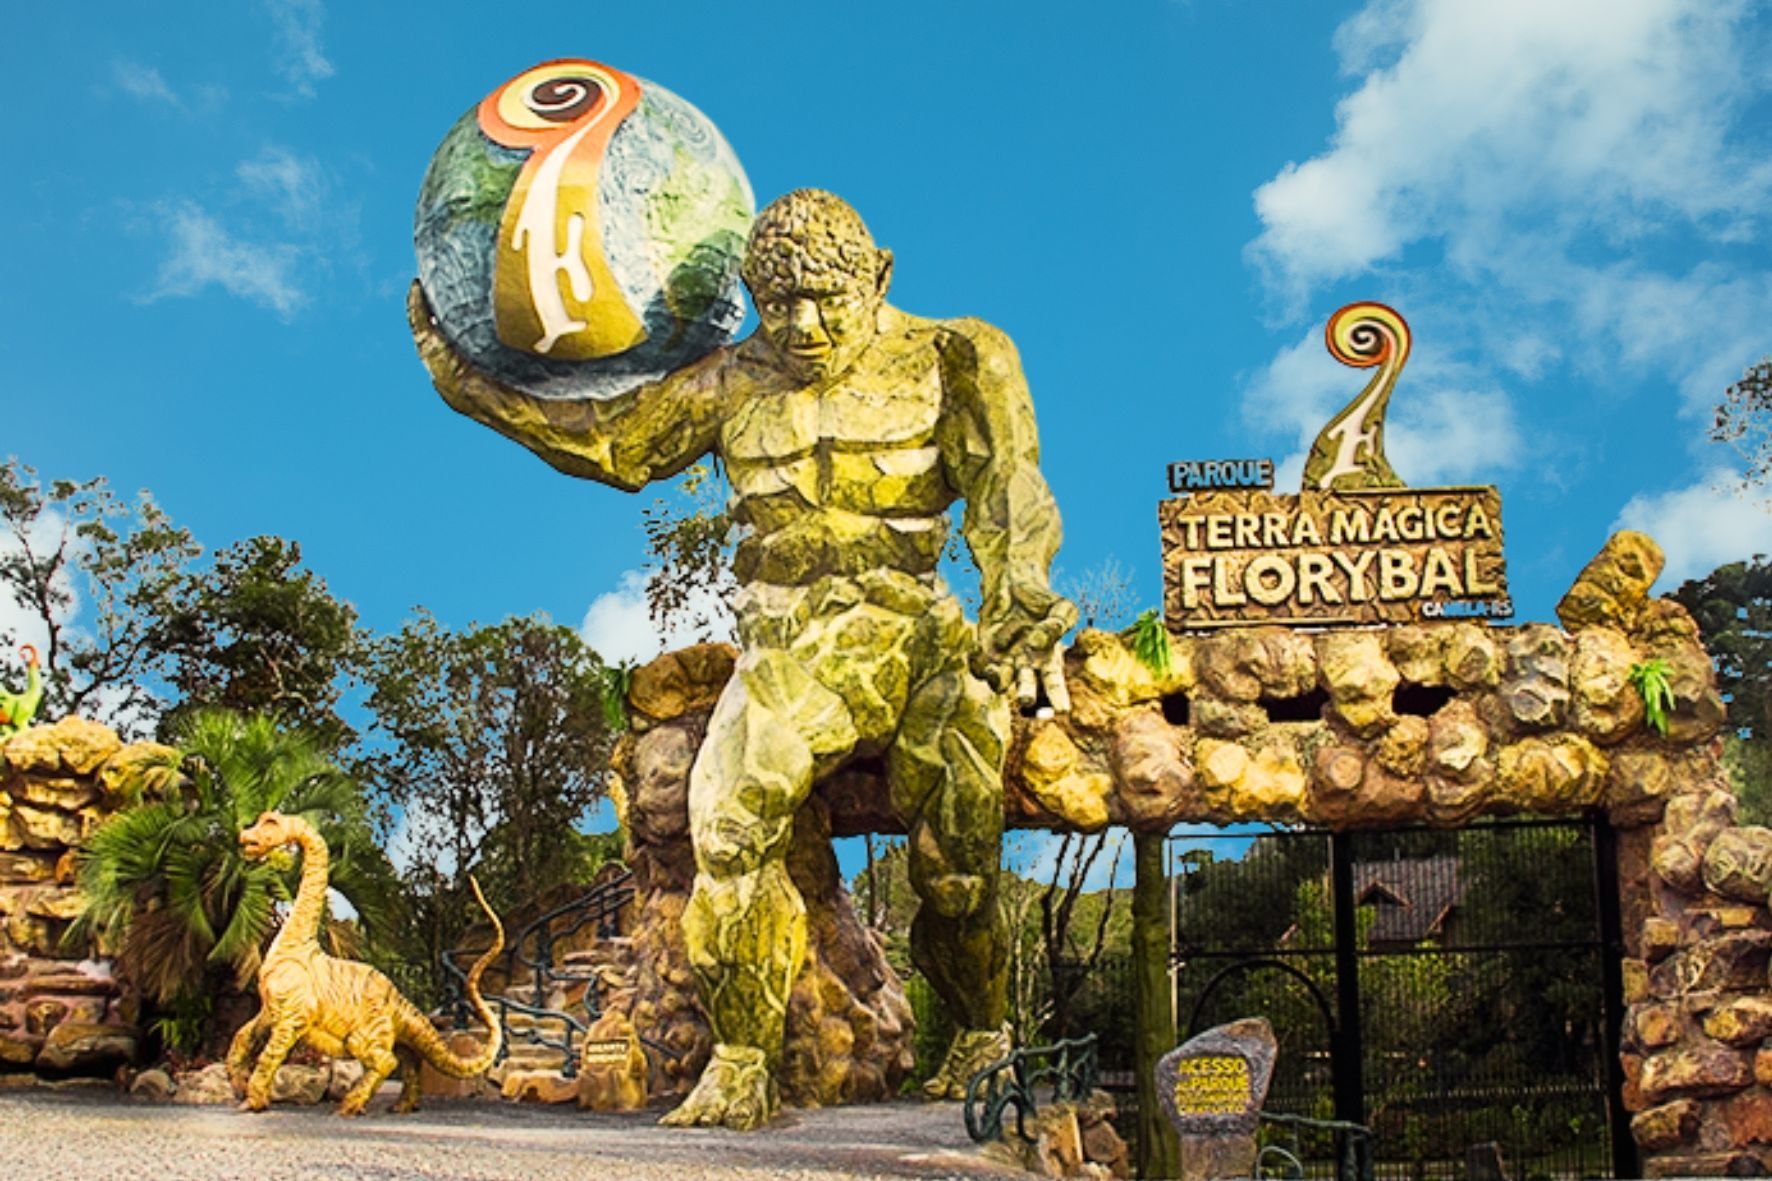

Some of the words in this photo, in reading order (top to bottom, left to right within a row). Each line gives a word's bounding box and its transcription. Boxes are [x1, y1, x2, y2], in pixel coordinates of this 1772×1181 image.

[1173, 460, 1272, 488] PARQUE
[1178, 513, 1321, 550] TERRA
[1329, 498, 1492, 544] MÁGICA
[1181, 548, 1498, 606] FLORYBAL
[1179, 1056, 1248, 1075] ACESSO
